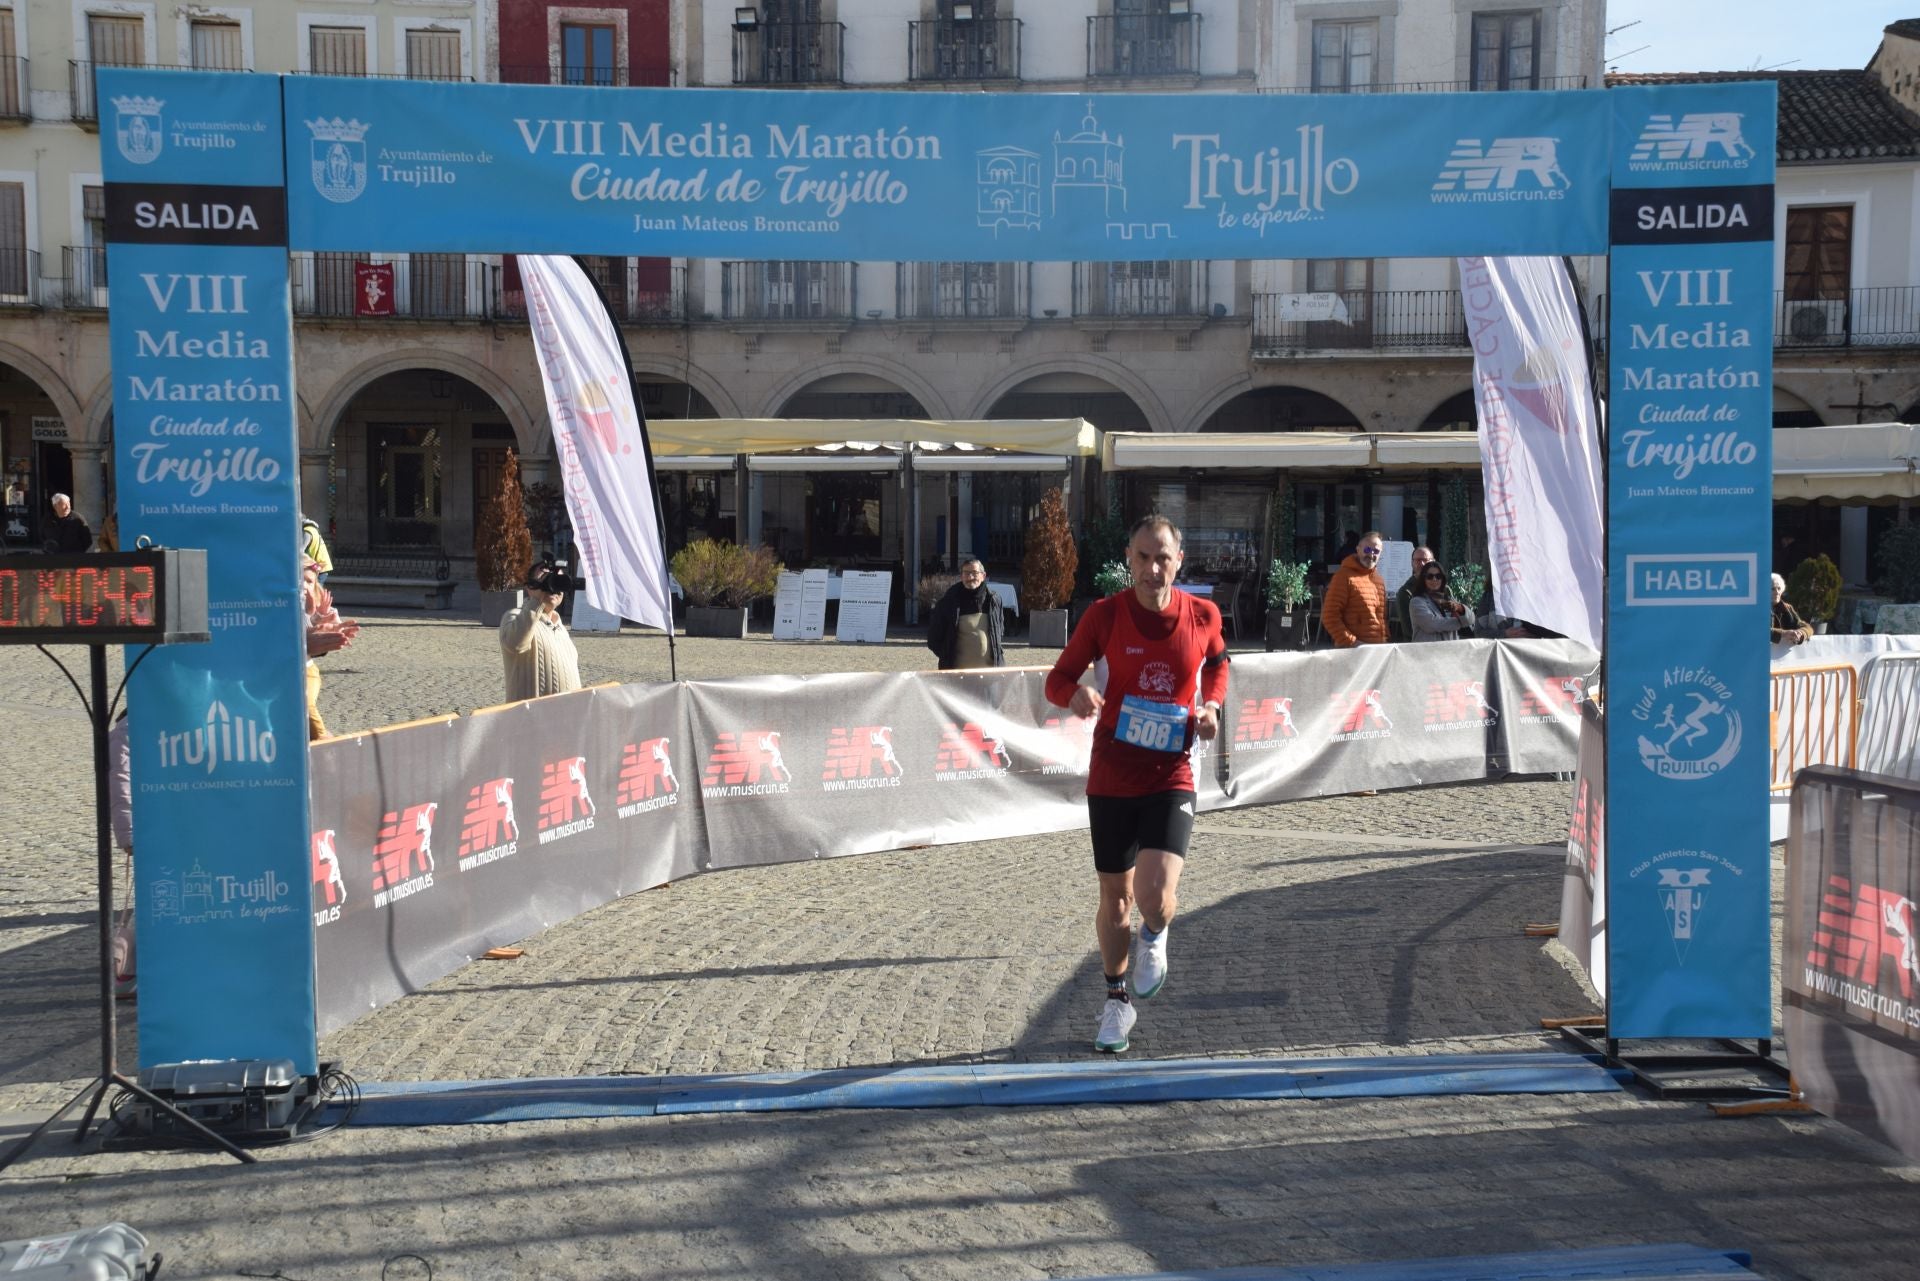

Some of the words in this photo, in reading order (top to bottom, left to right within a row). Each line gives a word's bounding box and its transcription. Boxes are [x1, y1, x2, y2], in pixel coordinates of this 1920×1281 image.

[171, 120, 249, 133] Ayuntamiento
[252, 121, 267, 133] de
[513, 118, 605, 156] VIII
[619, 121, 753, 158] Media
[766, 124, 942, 160] Maratón
[171, 133, 236, 152] Trujillo
[378, 148, 473, 164] Ayuntamiento
[476, 151, 493, 164] de
[1172, 124, 1359, 212] Trujillo
[1628, 157, 1749, 172] www.musicrun.es
[377, 164, 456, 188] Trujillo
[570, 162, 709, 201] Ciudad
[715, 169, 766, 201] de
[775, 166, 908, 218] Trujillo
[1431, 187, 1565, 203] www.musicrun.es
[135, 202, 259, 230] SALIDA
[633, 214, 677, 233] Juan
[681, 214, 749, 232] Mateos
[754, 216, 840, 233] Broncano
[1218, 202, 1239, 228] te
[1637, 204, 1749, 230] SALIDA
[140, 273, 248, 313] VIII
[1636, 269, 1733, 307] VIII
[135, 330, 271, 359] Media
[1629, 322, 1751, 349] Media
[128, 376, 282, 402] Maratón
[1622, 365, 1760, 390] Maratón
[150, 415, 229, 436] Ciudad
[233, 418, 261, 436] de
[1638, 403, 1709, 424] Ciudad
[1713, 403, 1740, 421] de
[1622, 429, 1757, 480] Trujillo
[131, 442, 280, 498] Trujillo
[1628, 487, 1654, 498] Juan
[1657, 486, 1698, 496] Mateos
[1701, 485, 1755, 496] Broncano
[140, 503, 168, 516] Juan
[172, 503, 217, 515] Mateos
[220, 503, 278, 514] Broncano
[1645, 568, 1738, 592] HABLA
[274, 597, 288, 608] de
[1632, 685, 1657, 720] Club
[1664, 666, 1733, 699] Atletismo
[158, 700, 277, 774] trujillo
[1126, 716, 1172, 749] 508
[1329, 729, 1392, 743] www.musicrun.es
[1424, 718, 1497, 732] www.musicrun.es
[936, 767, 1007, 782] www.musicrun.es
[1647, 755, 1720, 774] TRUJILLO
[703, 782, 789, 798] www.musicrun.es
[823, 774, 900, 792] www.musicrun.es
[617, 793, 677, 819] www.musicrun.es
[539, 816, 594, 845] www.musicrun.es
[459, 840, 517, 872] www.musicrun.es
[1629, 861, 1651, 878] Club
[1652, 848, 1697, 864] Athletico
[1699, 850, 1719, 862] San
[1720, 858, 1743, 876] José
[216, 870, 289, 903] Trujillo
[374, 872, 434, 908] www.musicrun.es
[240, 903, 251, 918] te
[1804, 967, 1920, 1028] www.musicrun.es
